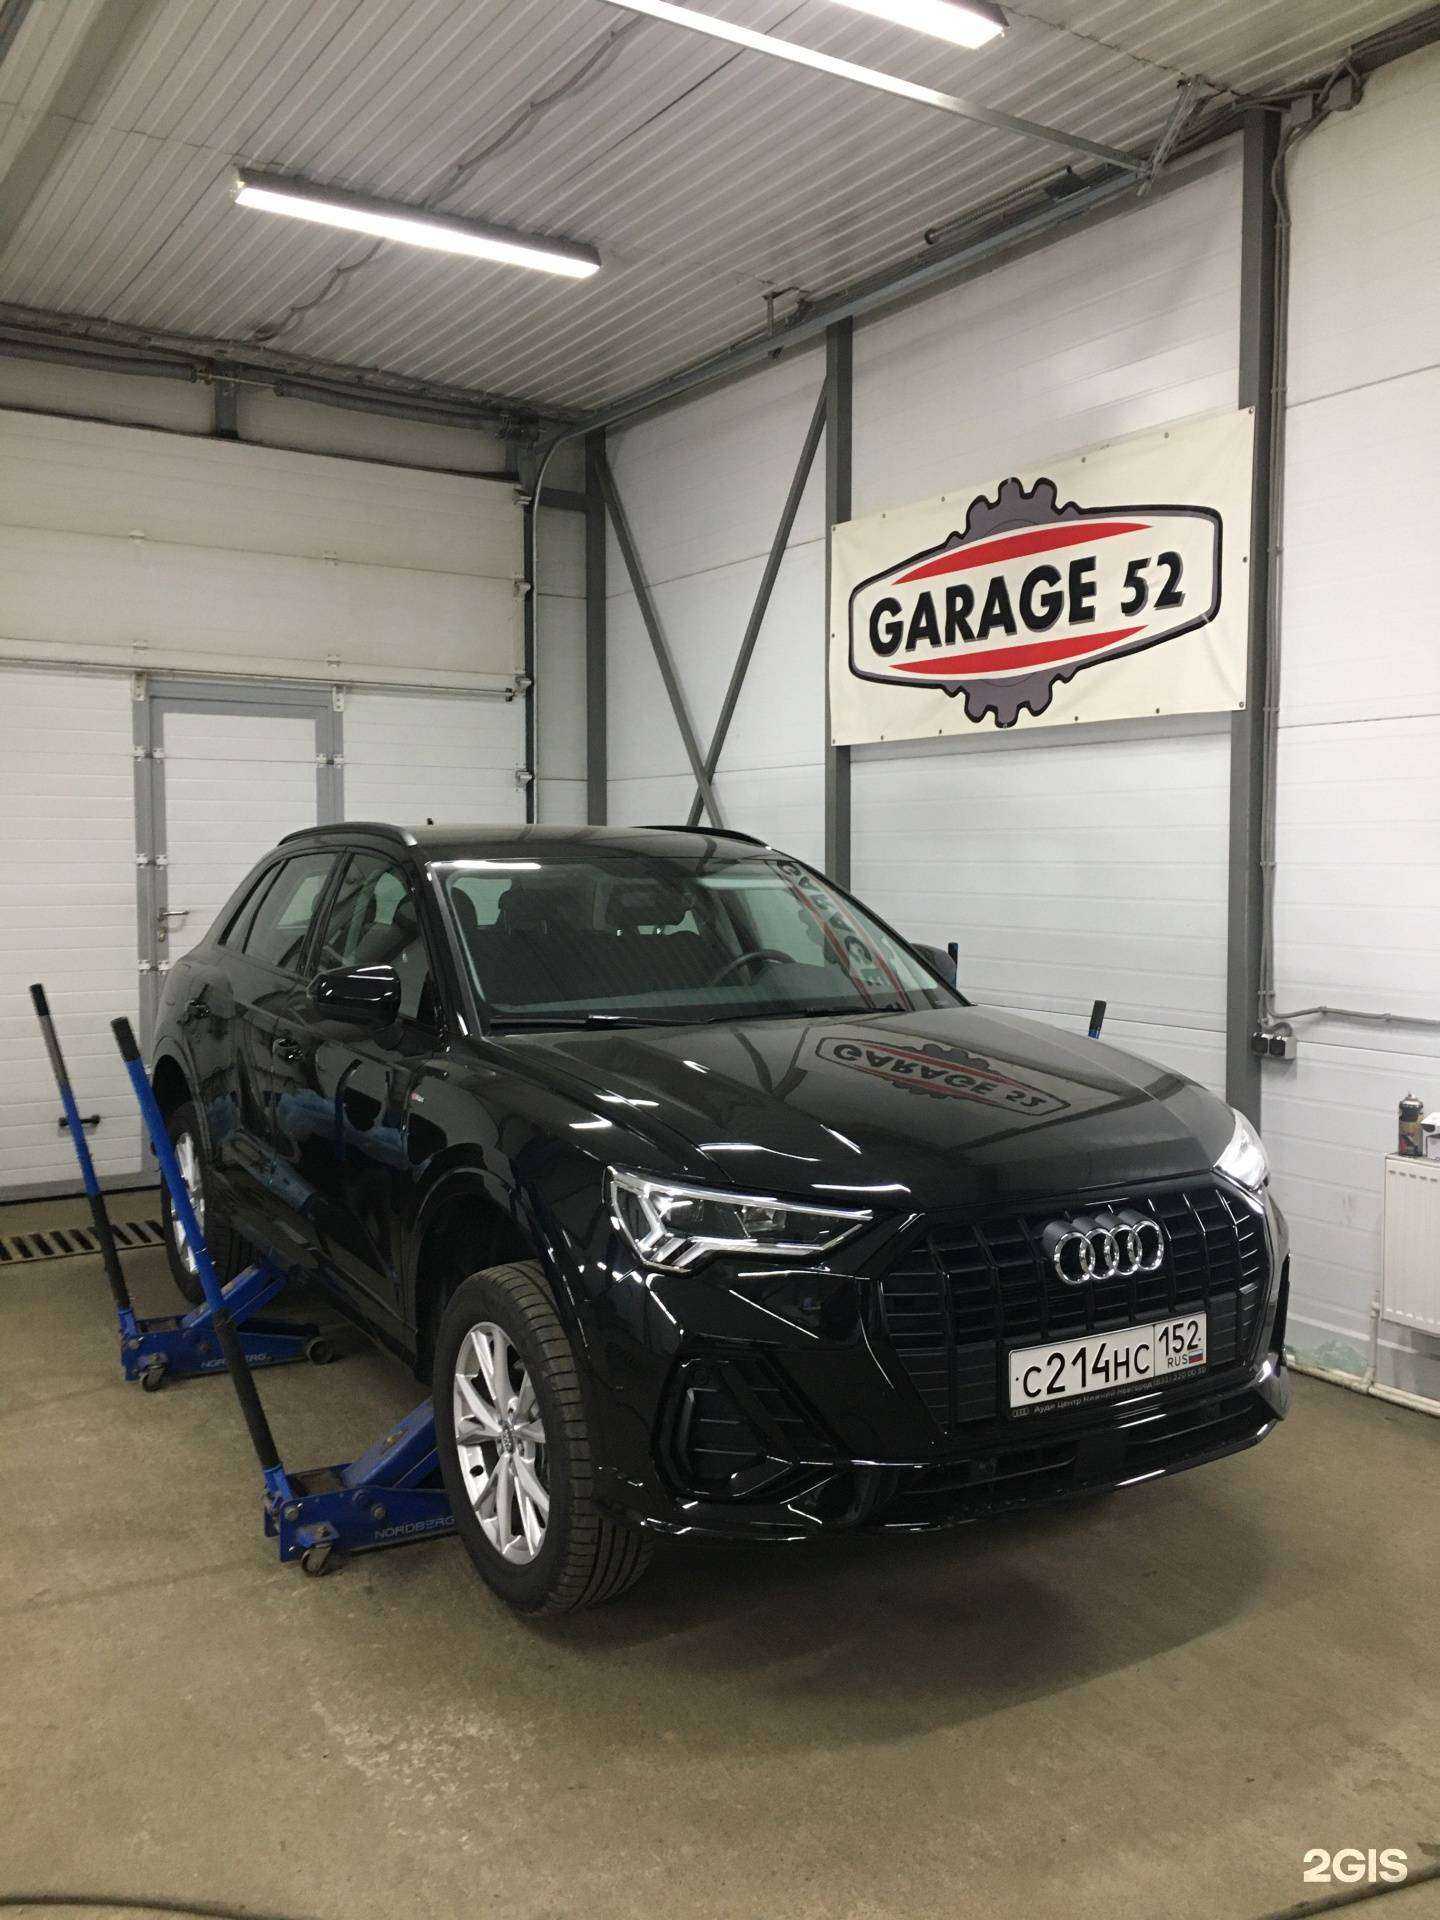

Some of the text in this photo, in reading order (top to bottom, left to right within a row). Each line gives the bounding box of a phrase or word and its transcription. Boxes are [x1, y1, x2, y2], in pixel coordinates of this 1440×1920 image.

[869, 551, 1186, 657] GARAGE 52
[1158, 1320, 1199, 1356] 152
[1167, 1353, 1188, 1369] RUS
[374, 1515, 456, 1540] NORDBERG
